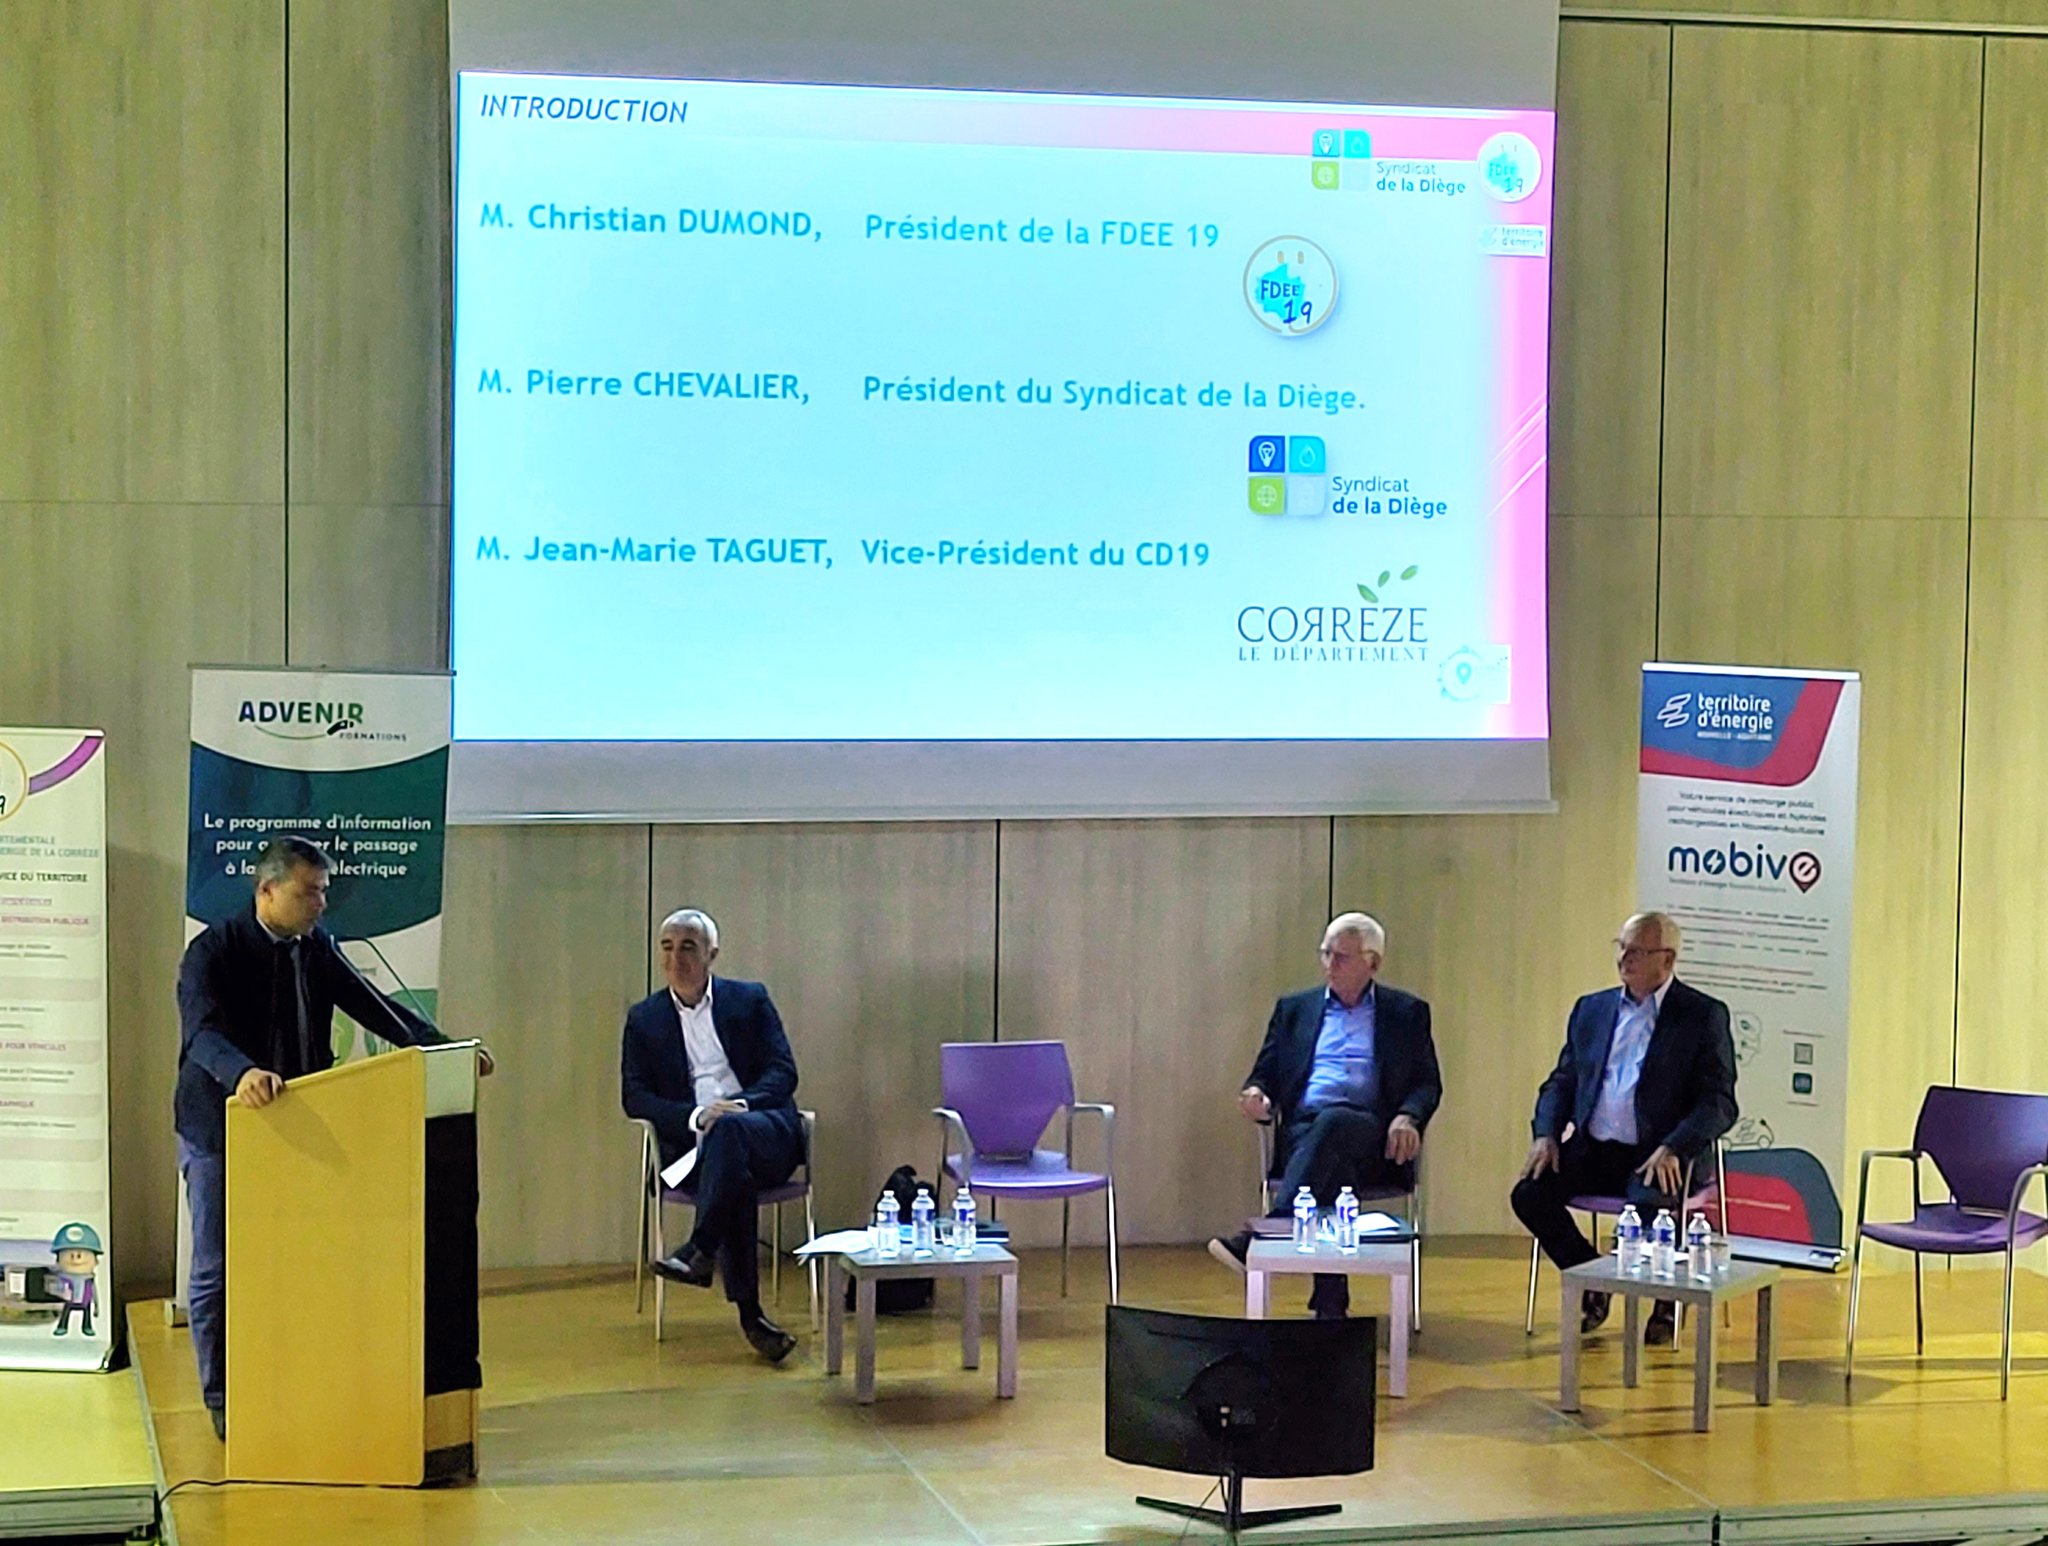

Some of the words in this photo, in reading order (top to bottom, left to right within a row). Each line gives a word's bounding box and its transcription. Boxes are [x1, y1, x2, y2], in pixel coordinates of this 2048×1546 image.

[481, 94, 688, 123] INTRODUCTION
[1376, 161, 1436, 176] Syndicat
[1376, 178, 1396, 191] de
[1402, 178, 1414, 191] la
[1420, 178, 1466, 196] Diège
[1504, 178, 1524, 193] 19
[480, 203, 514, 228] M.
[528, 204, 666, 233] Christian
[679, 209, 822, 242] DUMOND,
[865, 215, 1007, 243] Président
[1019, 218, 1055, 244] de
[1066, 219, 1090, 245] la
[1102, 221, 1174, 247] FDEE
[1187, 224, 1219, 249] 19
[1261, 279, 1300, 301] FDEE
[1283, 299, 1313, 325] 19
[478, 369, 512, 394] M.
[527, 369, 622, 396] Pierre
[634, 371, 810, 405] CHEVALIER,
[863, 376, 1007, 403] Président
[1017, 380, 1051, 405] du
[1064, 380, 1187, 412] Syndicat
[1197, 382, 1232, 407] de
[1244, 383, 1268, 408] la
[1279, 383, 1366, 415] Diège.
[1332, 475, 1410, 496] Syndicat
[1332, 497, 1359, 515] de
[1365, 497, 1381, 515] la
[1388, 496, 1448, 519] Diège
[476, 536, 510, 561] M.
[524, 536, 697, 563] Jean-Marie
[707, 538, 833, 569] TAGUET,
[861, 539, 1078, 566] Vice-Président
[1089, 541, 1124, 566] du
[1135, 542, 1210, 567] CD19
[1239, 647, 1260, 661] LE
[238, 700, 364, 724] ADVENIR
[1698, 692, 1771, 712] territoire
[1698, 709, 1774, 733] d'énergie
[339, 732, 407, 742] FORMATIONS
[203, 812, 225, 829] Le
[229, 814, 321, 832] programme
[326, 813, 432, 831] d'information
[215, 838, 252, 854] pour
[335, 836, 348, 851] le
[353, 839, 418, 855] passage
[225, 858, 236, 874] à
[241, 858, 256, 874] la
[1668, 841, 1822, 893] mobive
[36, 872, 88, 882] TERRITOIRE
